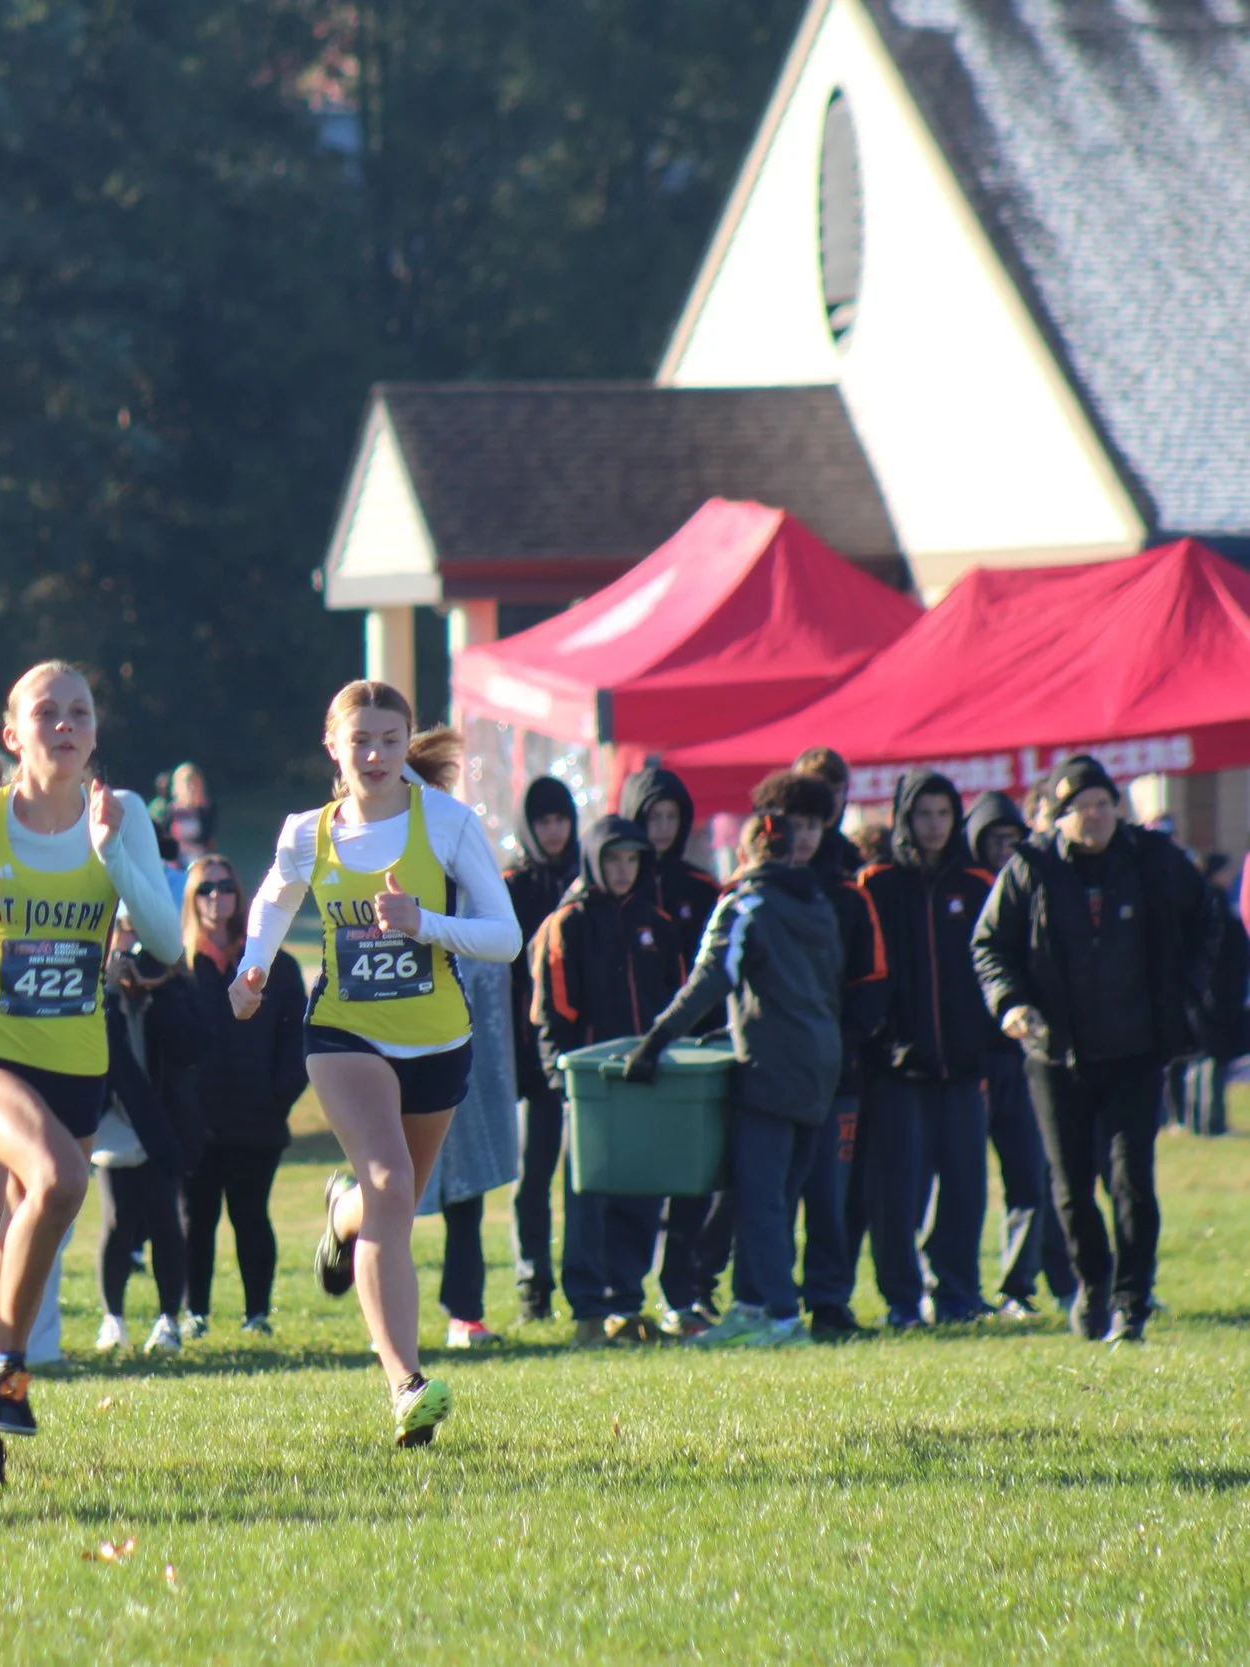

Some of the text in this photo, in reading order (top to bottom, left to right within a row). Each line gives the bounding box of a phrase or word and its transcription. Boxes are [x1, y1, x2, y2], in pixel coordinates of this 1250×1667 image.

[24, 899, 104, 935] JOSEPH
[351, 951, 418, 981] 426
[13, 968, 84, 998] 422
